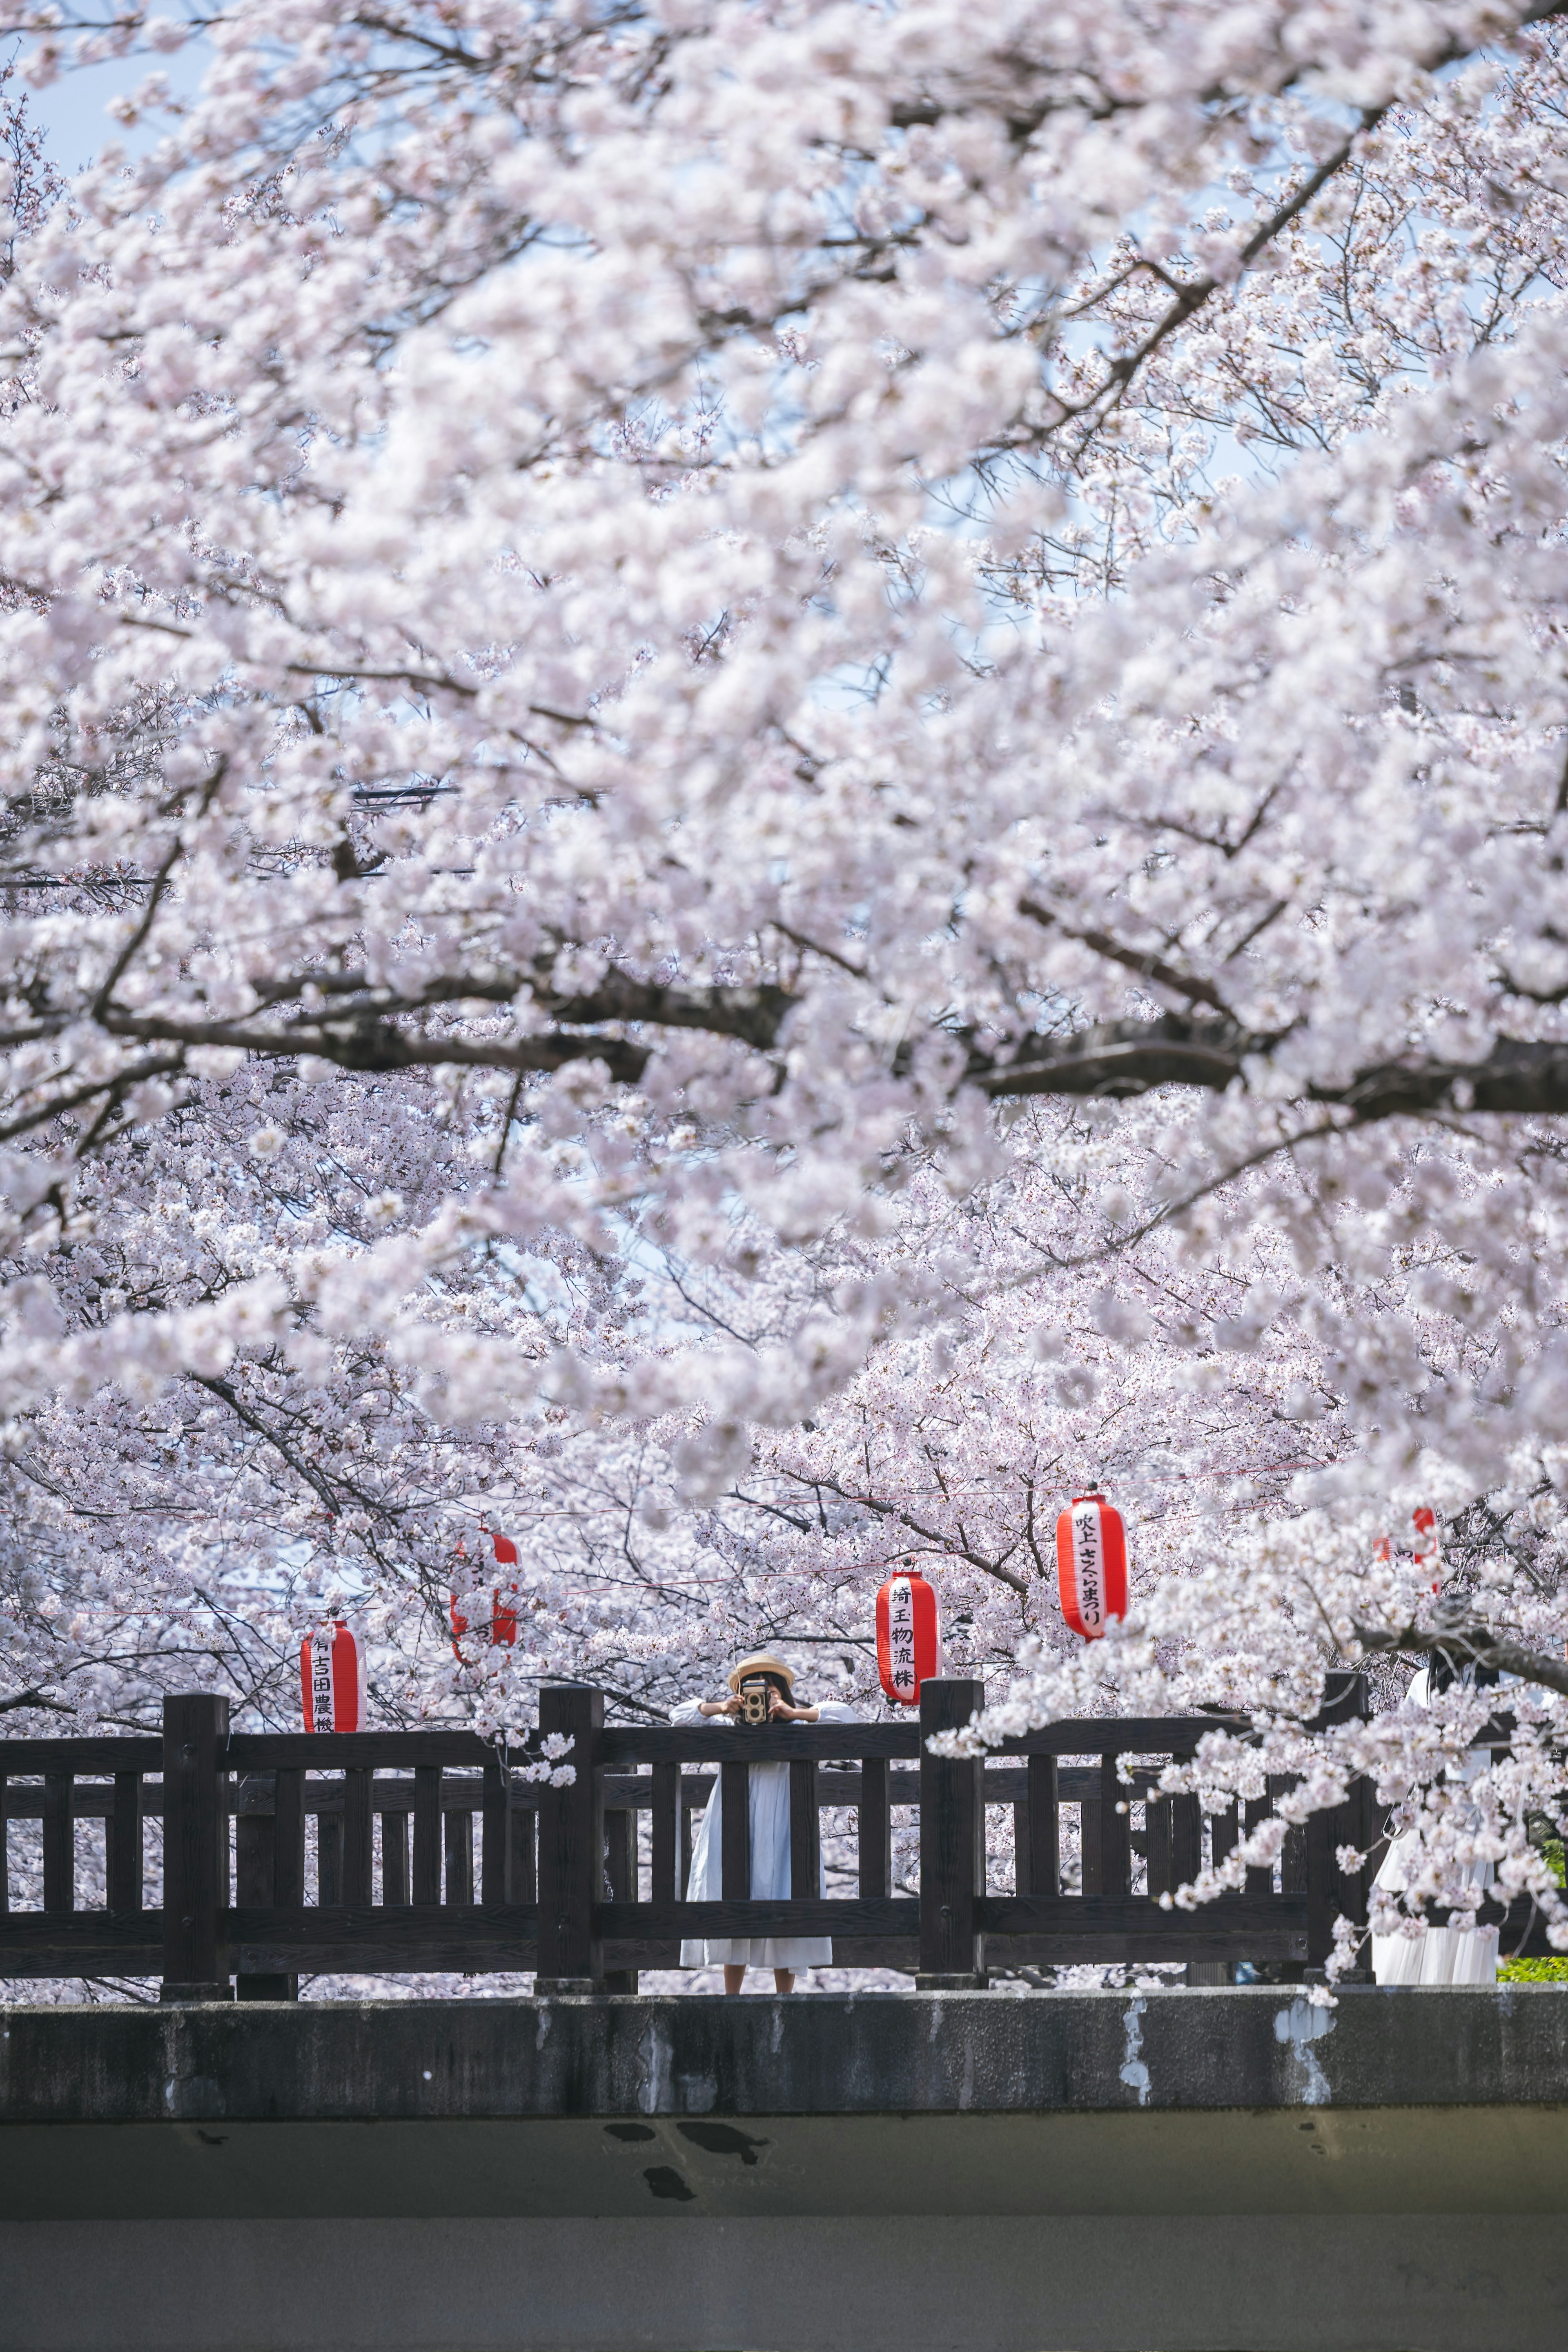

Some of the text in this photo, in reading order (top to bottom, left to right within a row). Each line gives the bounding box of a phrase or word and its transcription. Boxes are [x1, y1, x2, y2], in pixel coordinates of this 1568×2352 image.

[1076, 1514, 1099, 1625] 吹上さくらまつり
